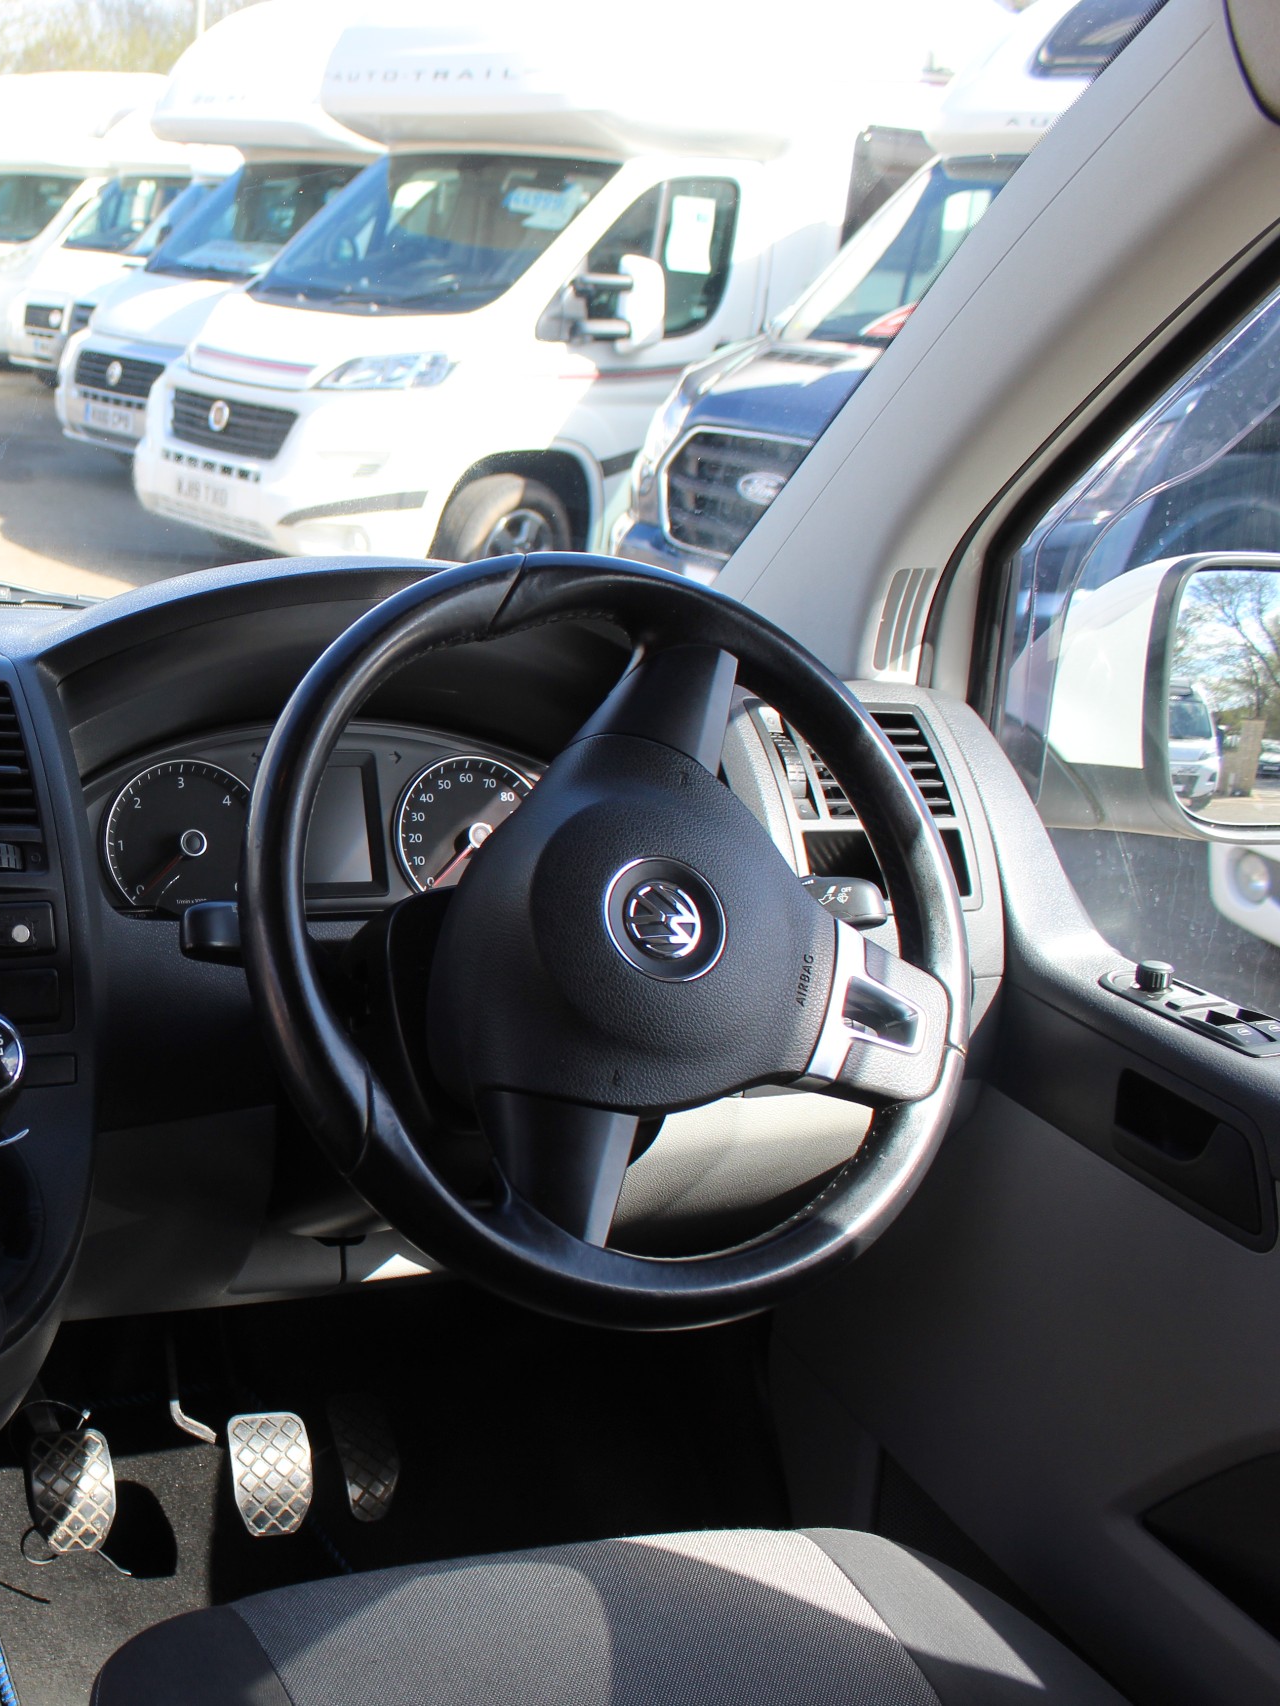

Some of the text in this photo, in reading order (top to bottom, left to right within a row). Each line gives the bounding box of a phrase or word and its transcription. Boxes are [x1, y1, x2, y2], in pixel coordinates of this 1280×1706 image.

[177, 777, 185, 788] 3
[459, 773, 473, 783] 60
[483, 778, 497, 788] 70
[437, 780, 451, 789] 50
[222, 795, 232, 806] 4
[420, 793, 434, 802] 40
[500, 792, 515, 802] 80
[133, 798, 142, 809] 2
[411, 812, 425, 822] 30
[408, 833, 423, 843] 20
[118, 840, 124, 851] 1
[413, 856, 426, 866] 10
[426, 877, 435, 886] 0
[795, 954, 814, 1007] AIRBAG
